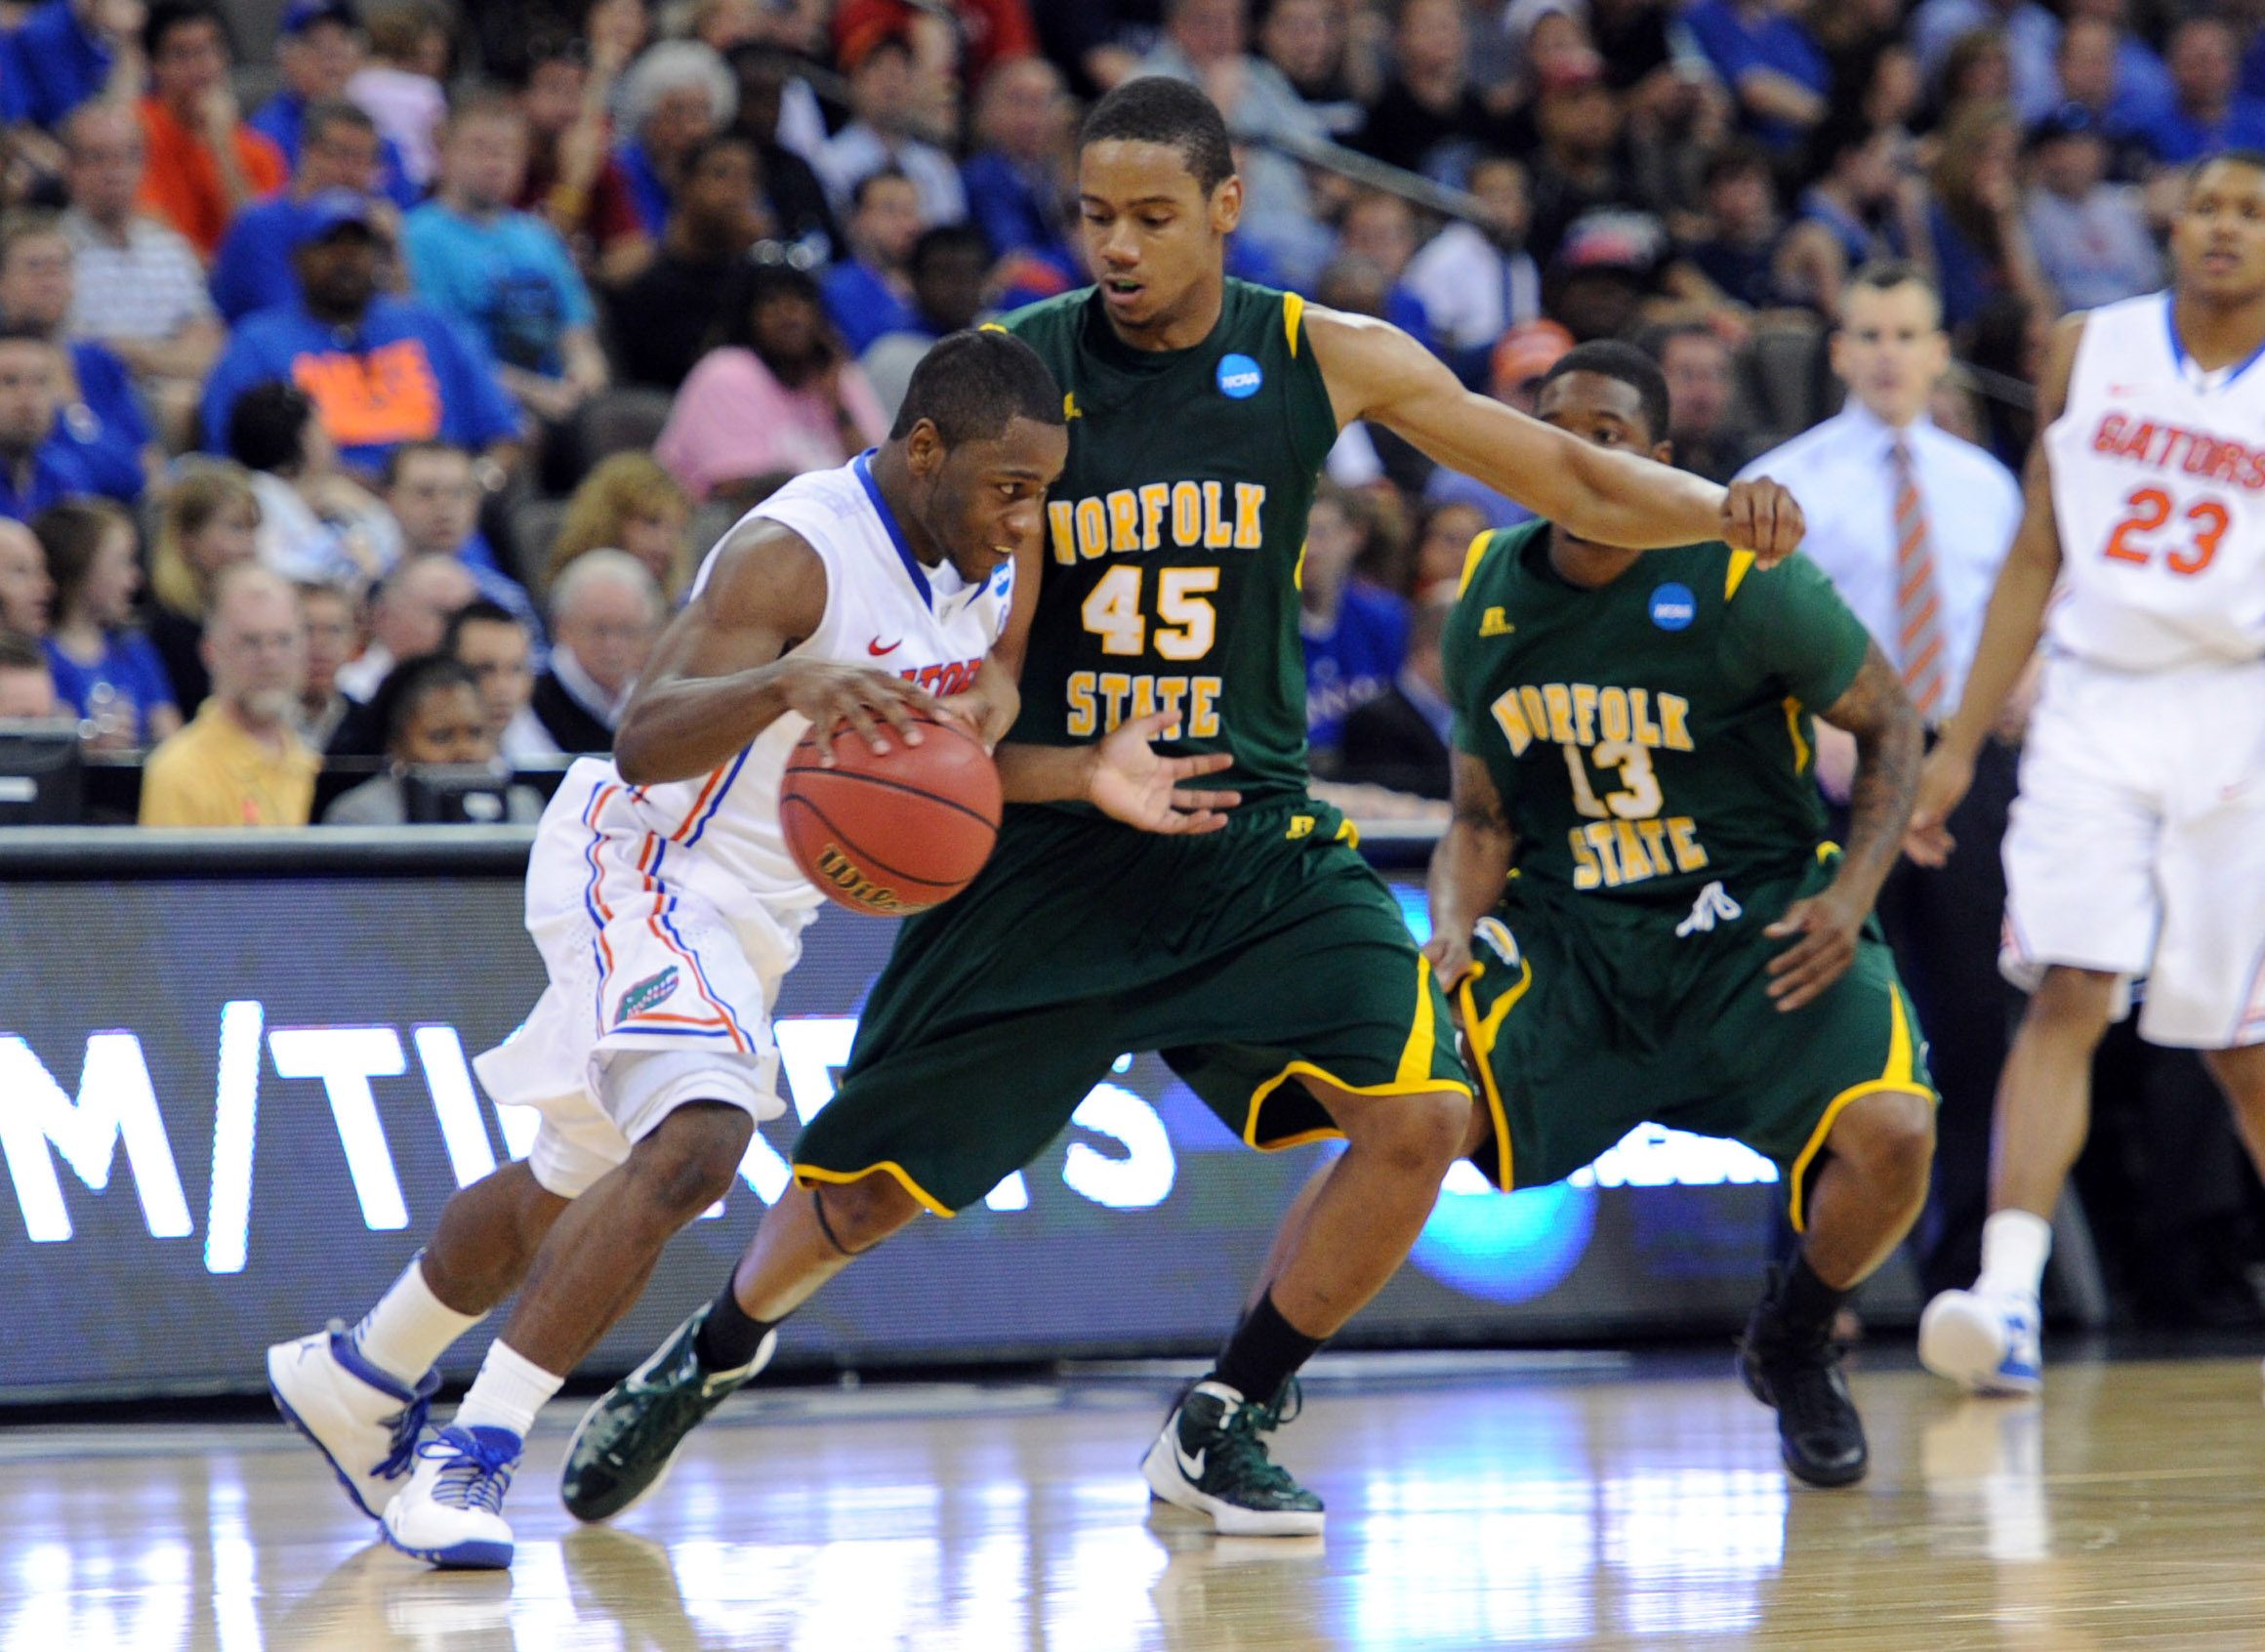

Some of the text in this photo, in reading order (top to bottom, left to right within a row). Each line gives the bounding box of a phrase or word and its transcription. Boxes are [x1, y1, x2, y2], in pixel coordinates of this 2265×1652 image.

[2094, 415, 2265, 488] GATORS
[1048, 480, 1266, 566] NORFOLK
[2106, 488, 2229, 574] 23
[1081, 564, 1220, 661] 45
[1066, 670, 1222, 741] STATE
[1490, 682, 1696, 758] NORFOLK
[1563, 739, 1665, 820] 13
[1567, 815, 1709, 890] STATE
